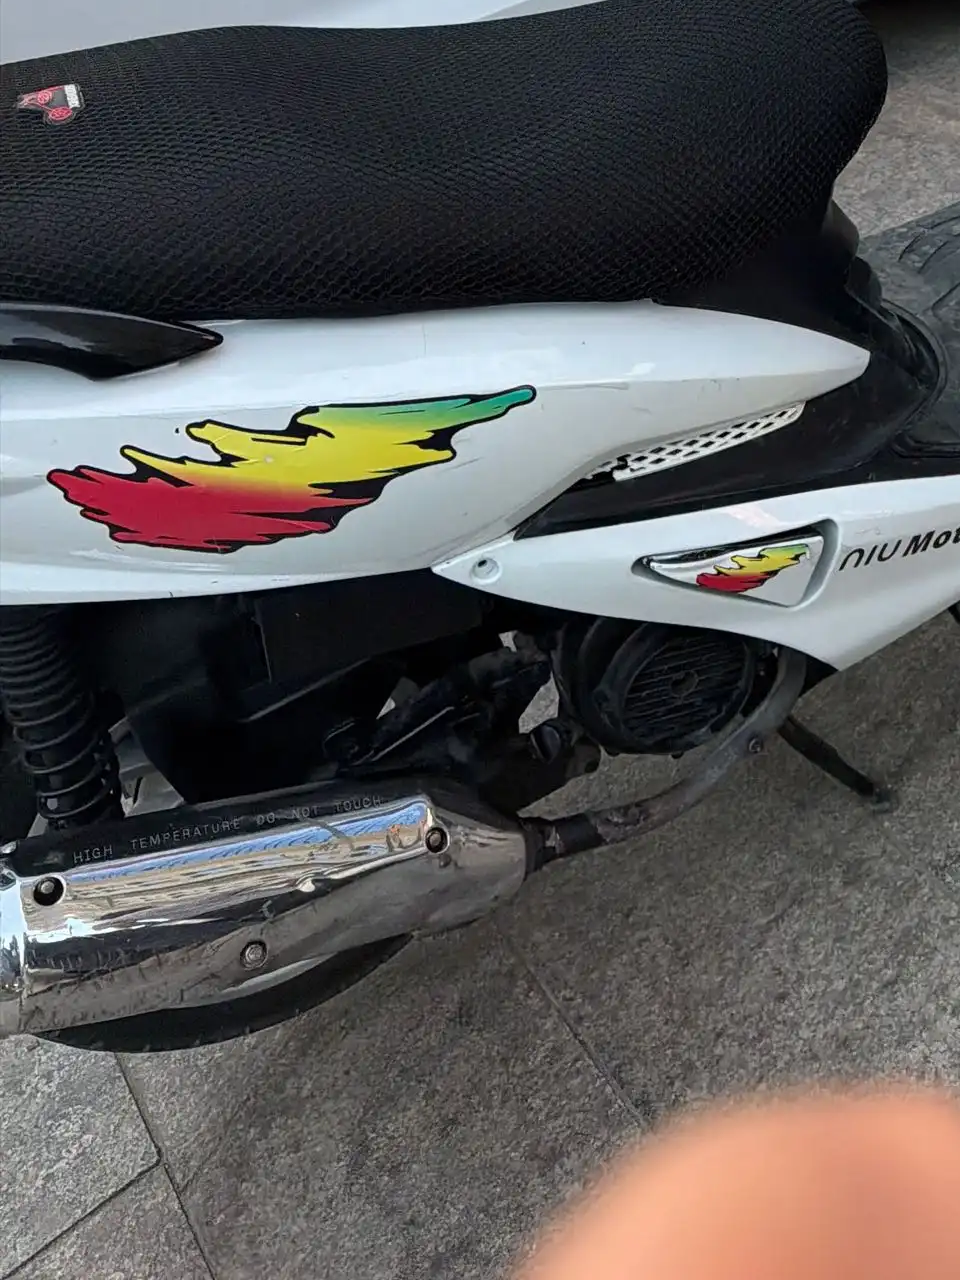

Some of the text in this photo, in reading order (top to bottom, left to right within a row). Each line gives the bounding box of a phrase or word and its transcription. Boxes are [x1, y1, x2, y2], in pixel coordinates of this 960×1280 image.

[73, 796, 382, 864] HIGH TEMPERATURE DO NOT TOUCH
